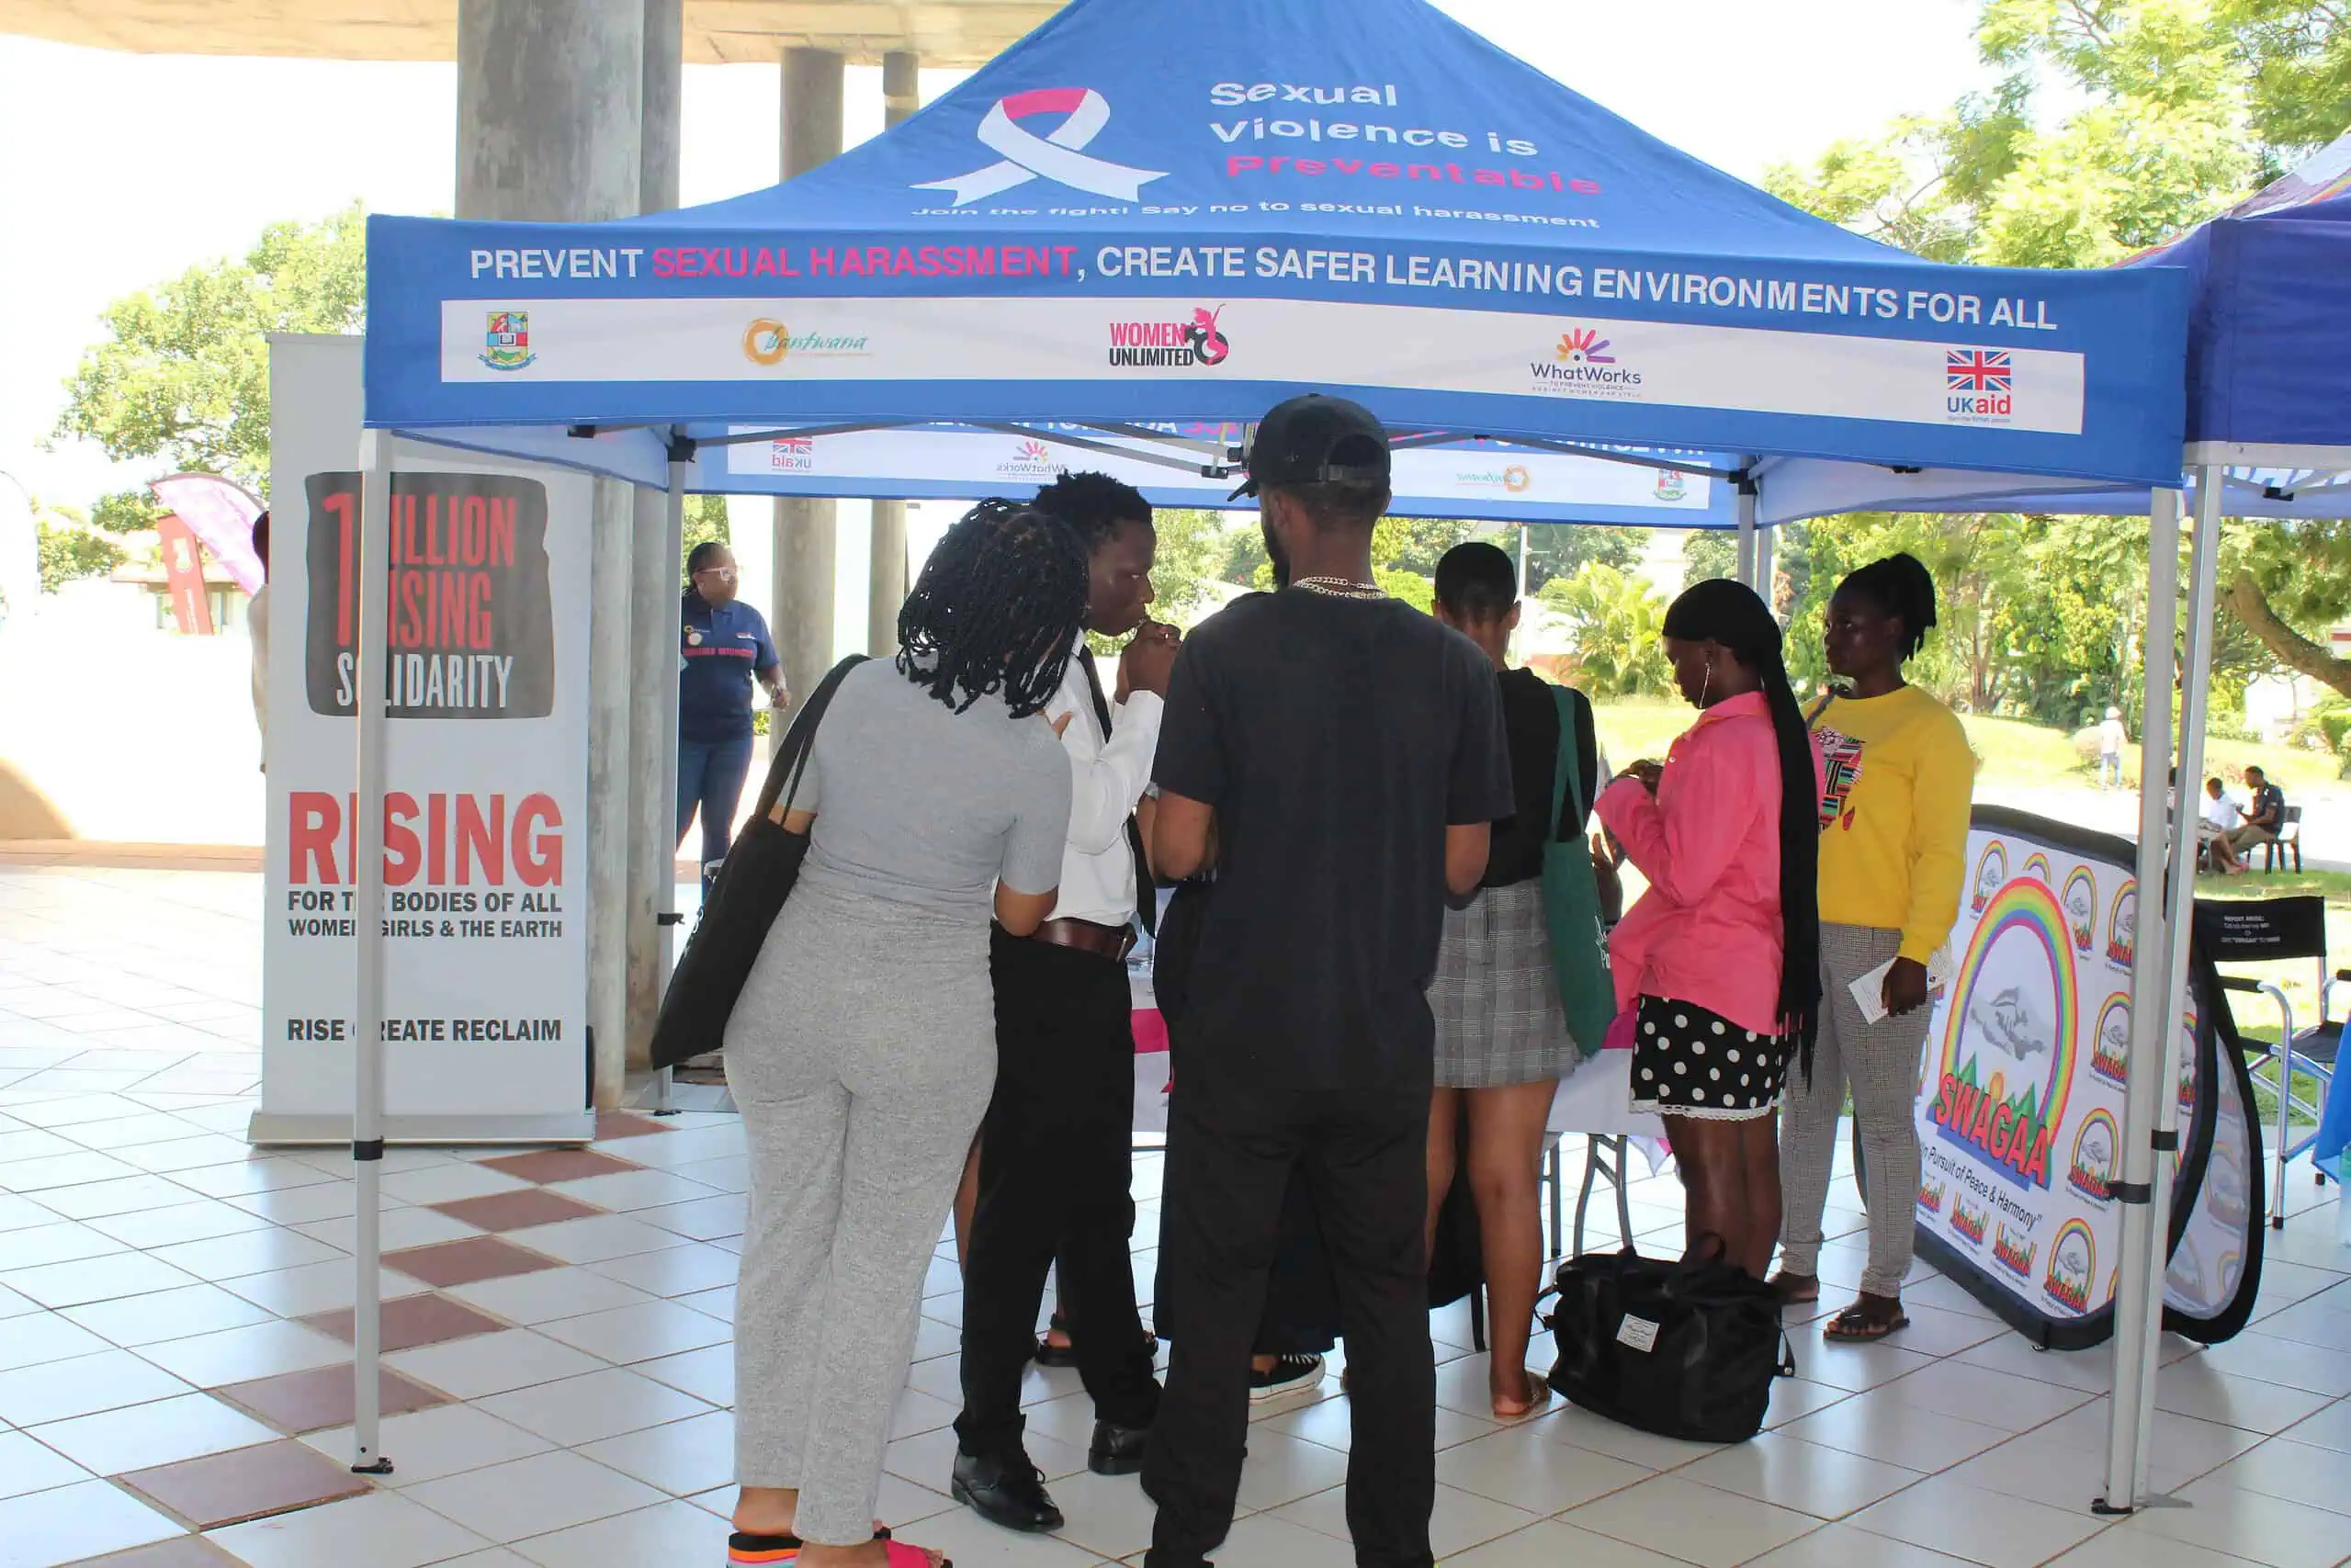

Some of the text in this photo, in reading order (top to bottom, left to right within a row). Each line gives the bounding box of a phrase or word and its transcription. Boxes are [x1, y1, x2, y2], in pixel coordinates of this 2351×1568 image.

[1209, 82, 1397, 107] Sexual
[1209, 117, 1539, 156] Violence is
[910, 200, 1600, 229] Join the fight! Say no to sexual harassment
[470, 245, 2059, 332] PREVENT SEXUAL HARASSMENT, CREATE SAFER LEARNING ENVIRONMENTS FOR ALL
[1109, 321, 1187, 347] WOMEN
[1109, 347, 1194, 367] UNLIMITED
[1531, 362, 1642, 385] WhatWorks
[390, 493, 518, 569] ILLION
[323, 492, 356, 648] 1
[388, 568, 493, 650] ISING
[335, 651, 514, 709] SIDARITY
[288, 890, 335, 912] FOR
[391, 891, 478, 913] BODIES
[484, 891, 514, 913] OF
[520, 893, 563, 914] ALL
[439, 919, 456, 939] &
[459, 919, 495, 938] THE
[501, 920, 563, 939] EARTH
[288, 1019, 345, 1042] RISE
[451, 1019, 562, 1043] RECLAIM
[1934, 1072, 2049, 1186] SWAGAA
[1928, 1145, 1956, 1177] Pursuit
[1955, 1165, 1967, 1182] of
[1964, 1168, 1989, 1198] Peace
[1988, 1185, 1997, 1203] &
